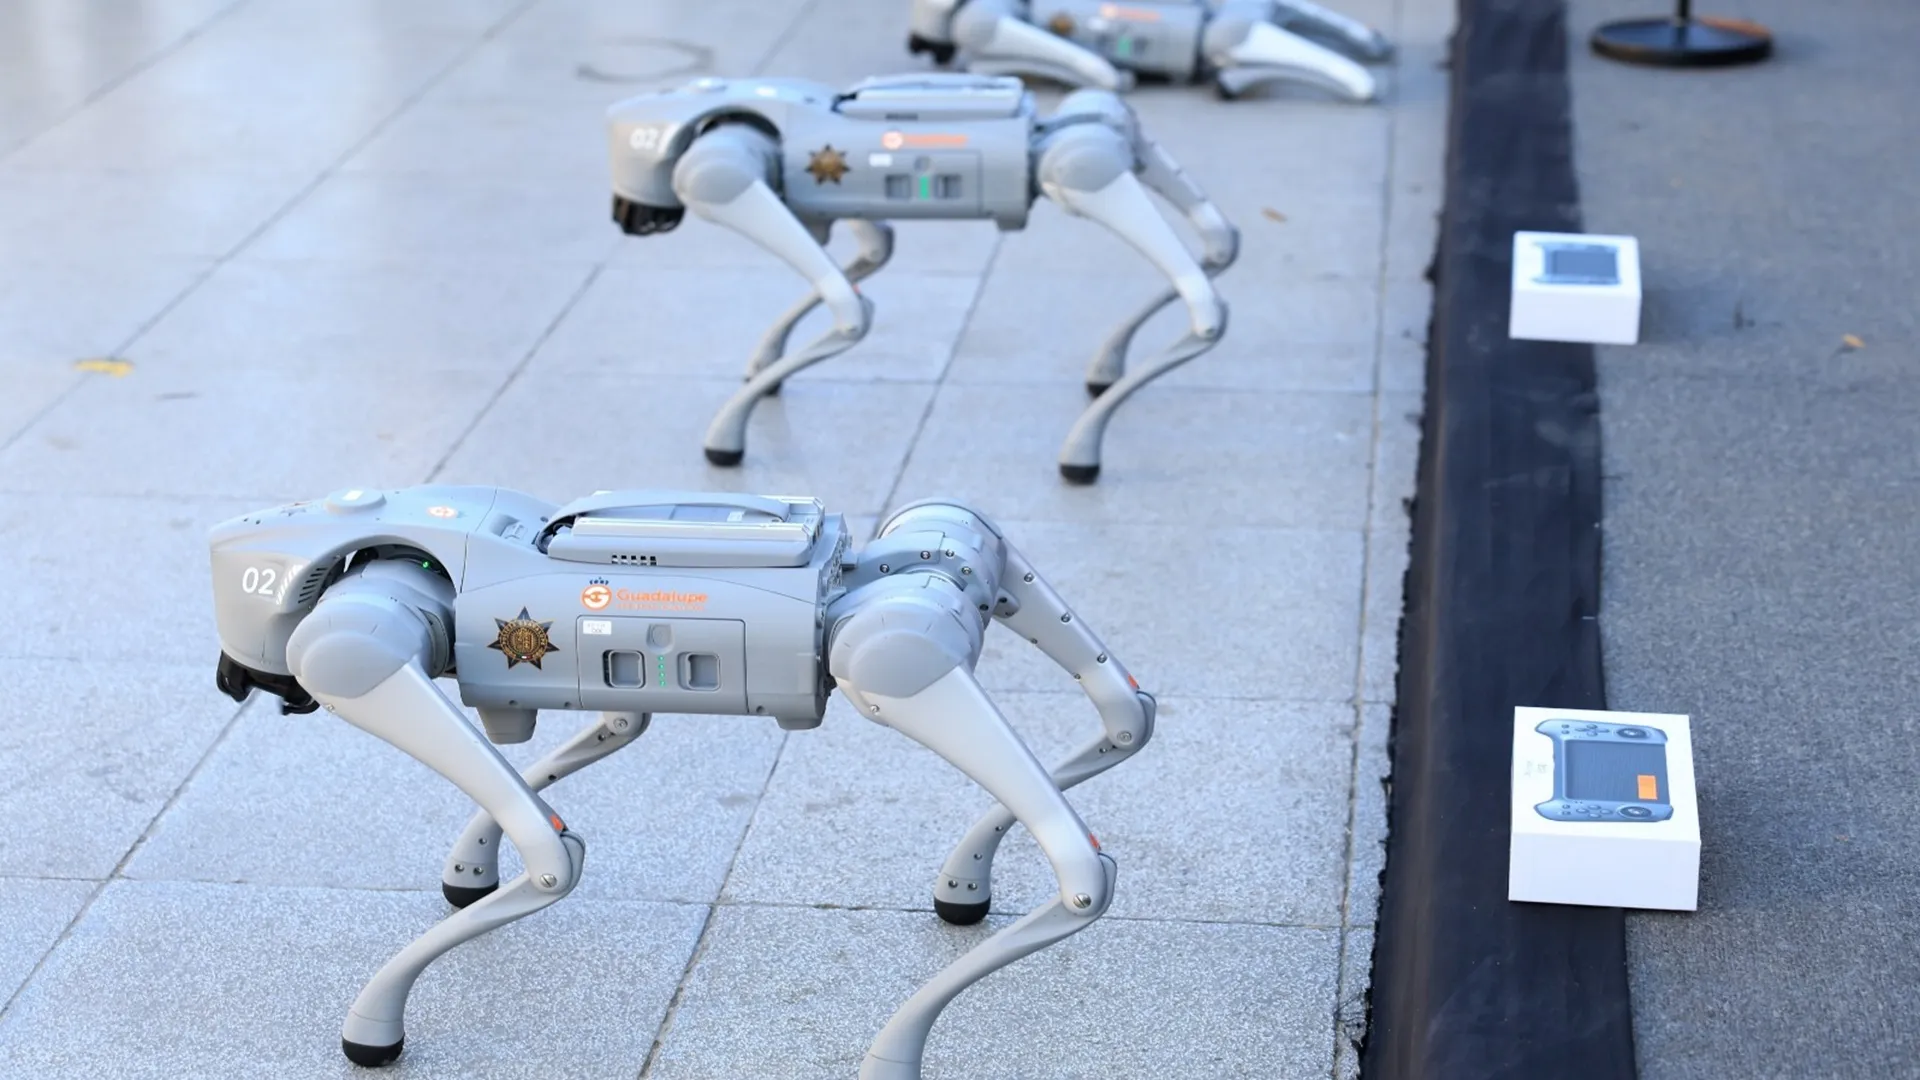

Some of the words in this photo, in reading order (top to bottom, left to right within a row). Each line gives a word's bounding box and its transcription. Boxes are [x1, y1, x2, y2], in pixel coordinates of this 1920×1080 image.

[629, 128, 658, 149] 02
[242, 567, 276, 595] 02
[616, 588, 708, 605] Guadalupe
